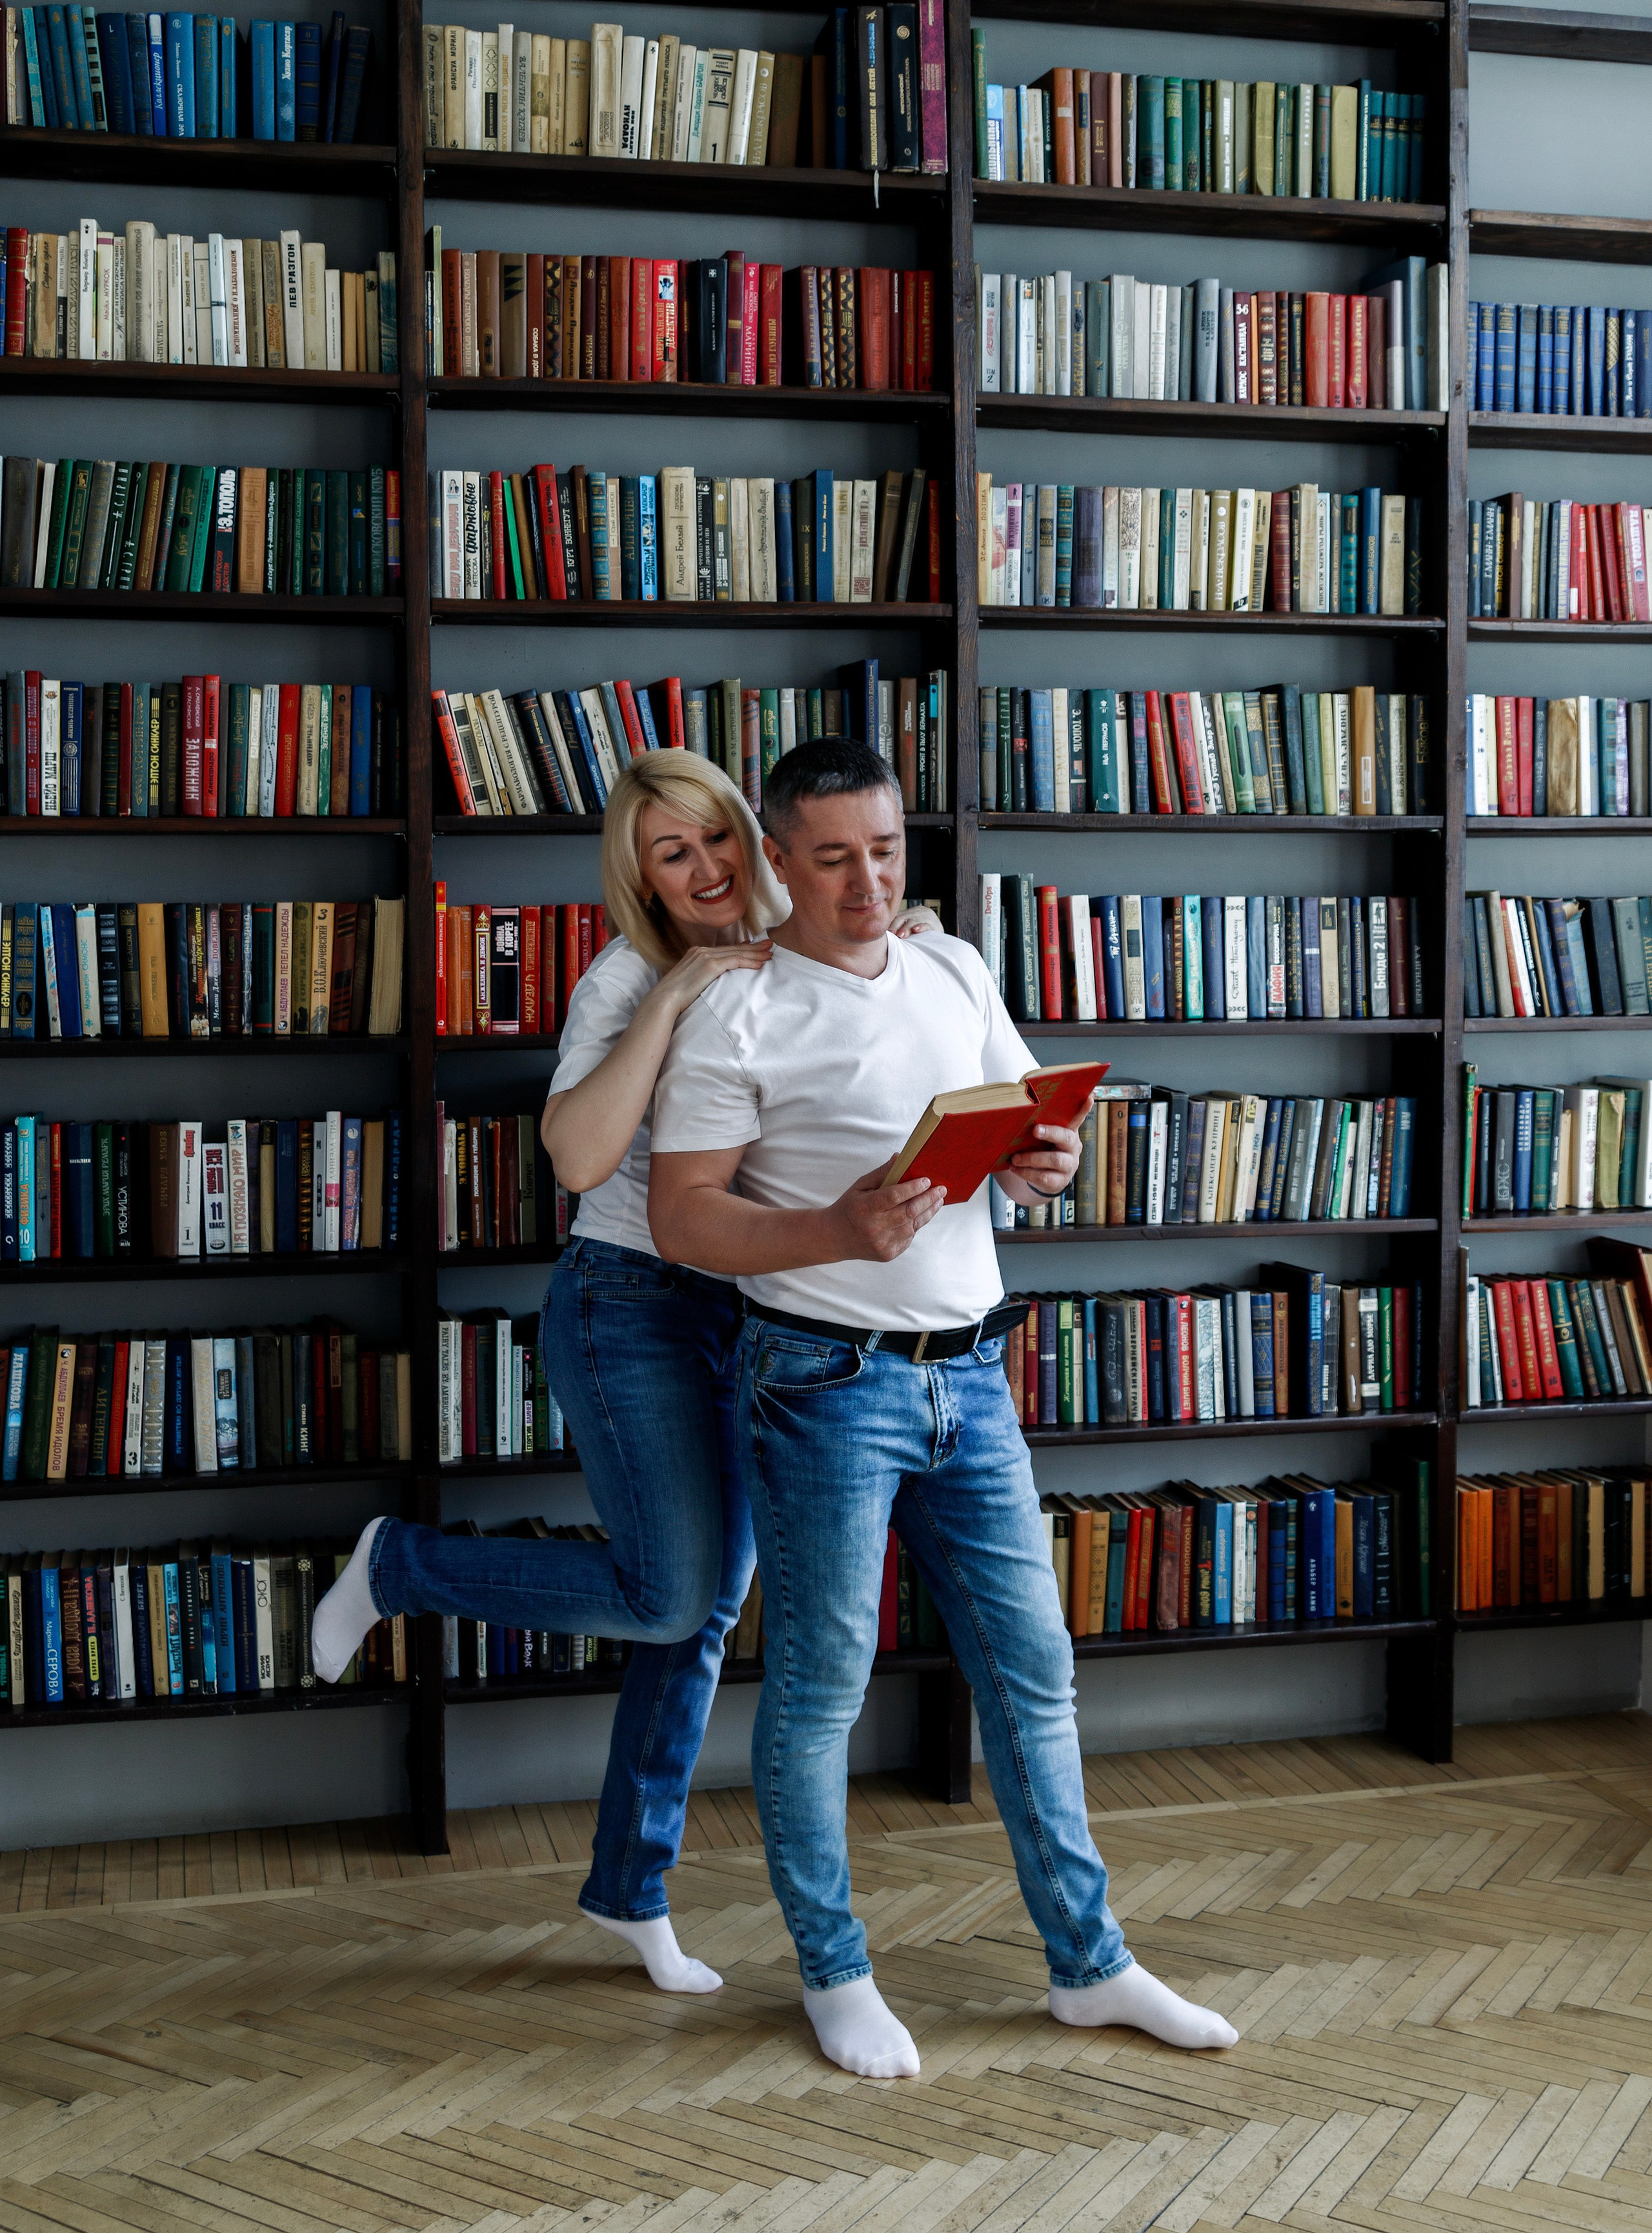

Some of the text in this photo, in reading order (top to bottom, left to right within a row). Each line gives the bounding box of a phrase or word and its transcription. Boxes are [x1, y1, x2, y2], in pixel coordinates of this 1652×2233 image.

[69, 244, 77, 273] НАЗОН
[288, 244, 296, 283] РАЗГОН
[655, 302, 665, 361] АМЕРИКАНСКИЙ
[1074, 332, 1083, 396] ПЛУТАРХ
[372, 469, 383, 493] КЛУБ
[675, 525, 686, 586] Андрей Белый
[487, 694, 509, 742] РЕЦЕПТУРОЙ
[45, 752, 57, 779] МАРШ
[504, 750, 527, 809] ФАРМАКОЛОГИЯ
[496, 925, 505, 952] ВОЙНА
[505, 922, 513, 948] КОРЕЕ
[1, 942, 11, 1007] ЭПТОН СИНКЛЕР
[1025, 947, 1034, 981] Сологуб
[1374, 952, 1387, 989] Банда
[280, 978, 288, 1012] АБДУЛЛАЕВ
[1027, 985, 1036, 1012] Федор
[1272, 966, 1283, 1002] МАФИЯ
[159, 1131, 168, 1207] РИЧАРД ХЬЮЗ
[206, 1149, 223, 1166] ВСЕ
[1207, 1116, 1220, 1200] АЛЕКСАНДР КУПРИН
[231, 1149, 247, 1242] Я ПОЗНАЮ МИР
[523, 1161, 534, 1200] Ковчег
[19, 1184, 30, 1225] ФИЗИКА
[118, 1186, 127, 1235] УСТИНОВА
[10, 1353, 23, 1410] ДАШКОВА
[58, 1368, 68, 1402] АБДУЛЛАЕВ
[442, 1373, 449, 1382] BY
[55, 1406, 65, 1435] БРЕМЯ
[52, 1436, 63, 1471] ИДОЛОВ
[299, 1428, 308, 1452] КИНГ
[1184, 1528, 1192, 1575] ШОЛОХОВ
[47, 1649, 58, 1696] СЕРОВА
